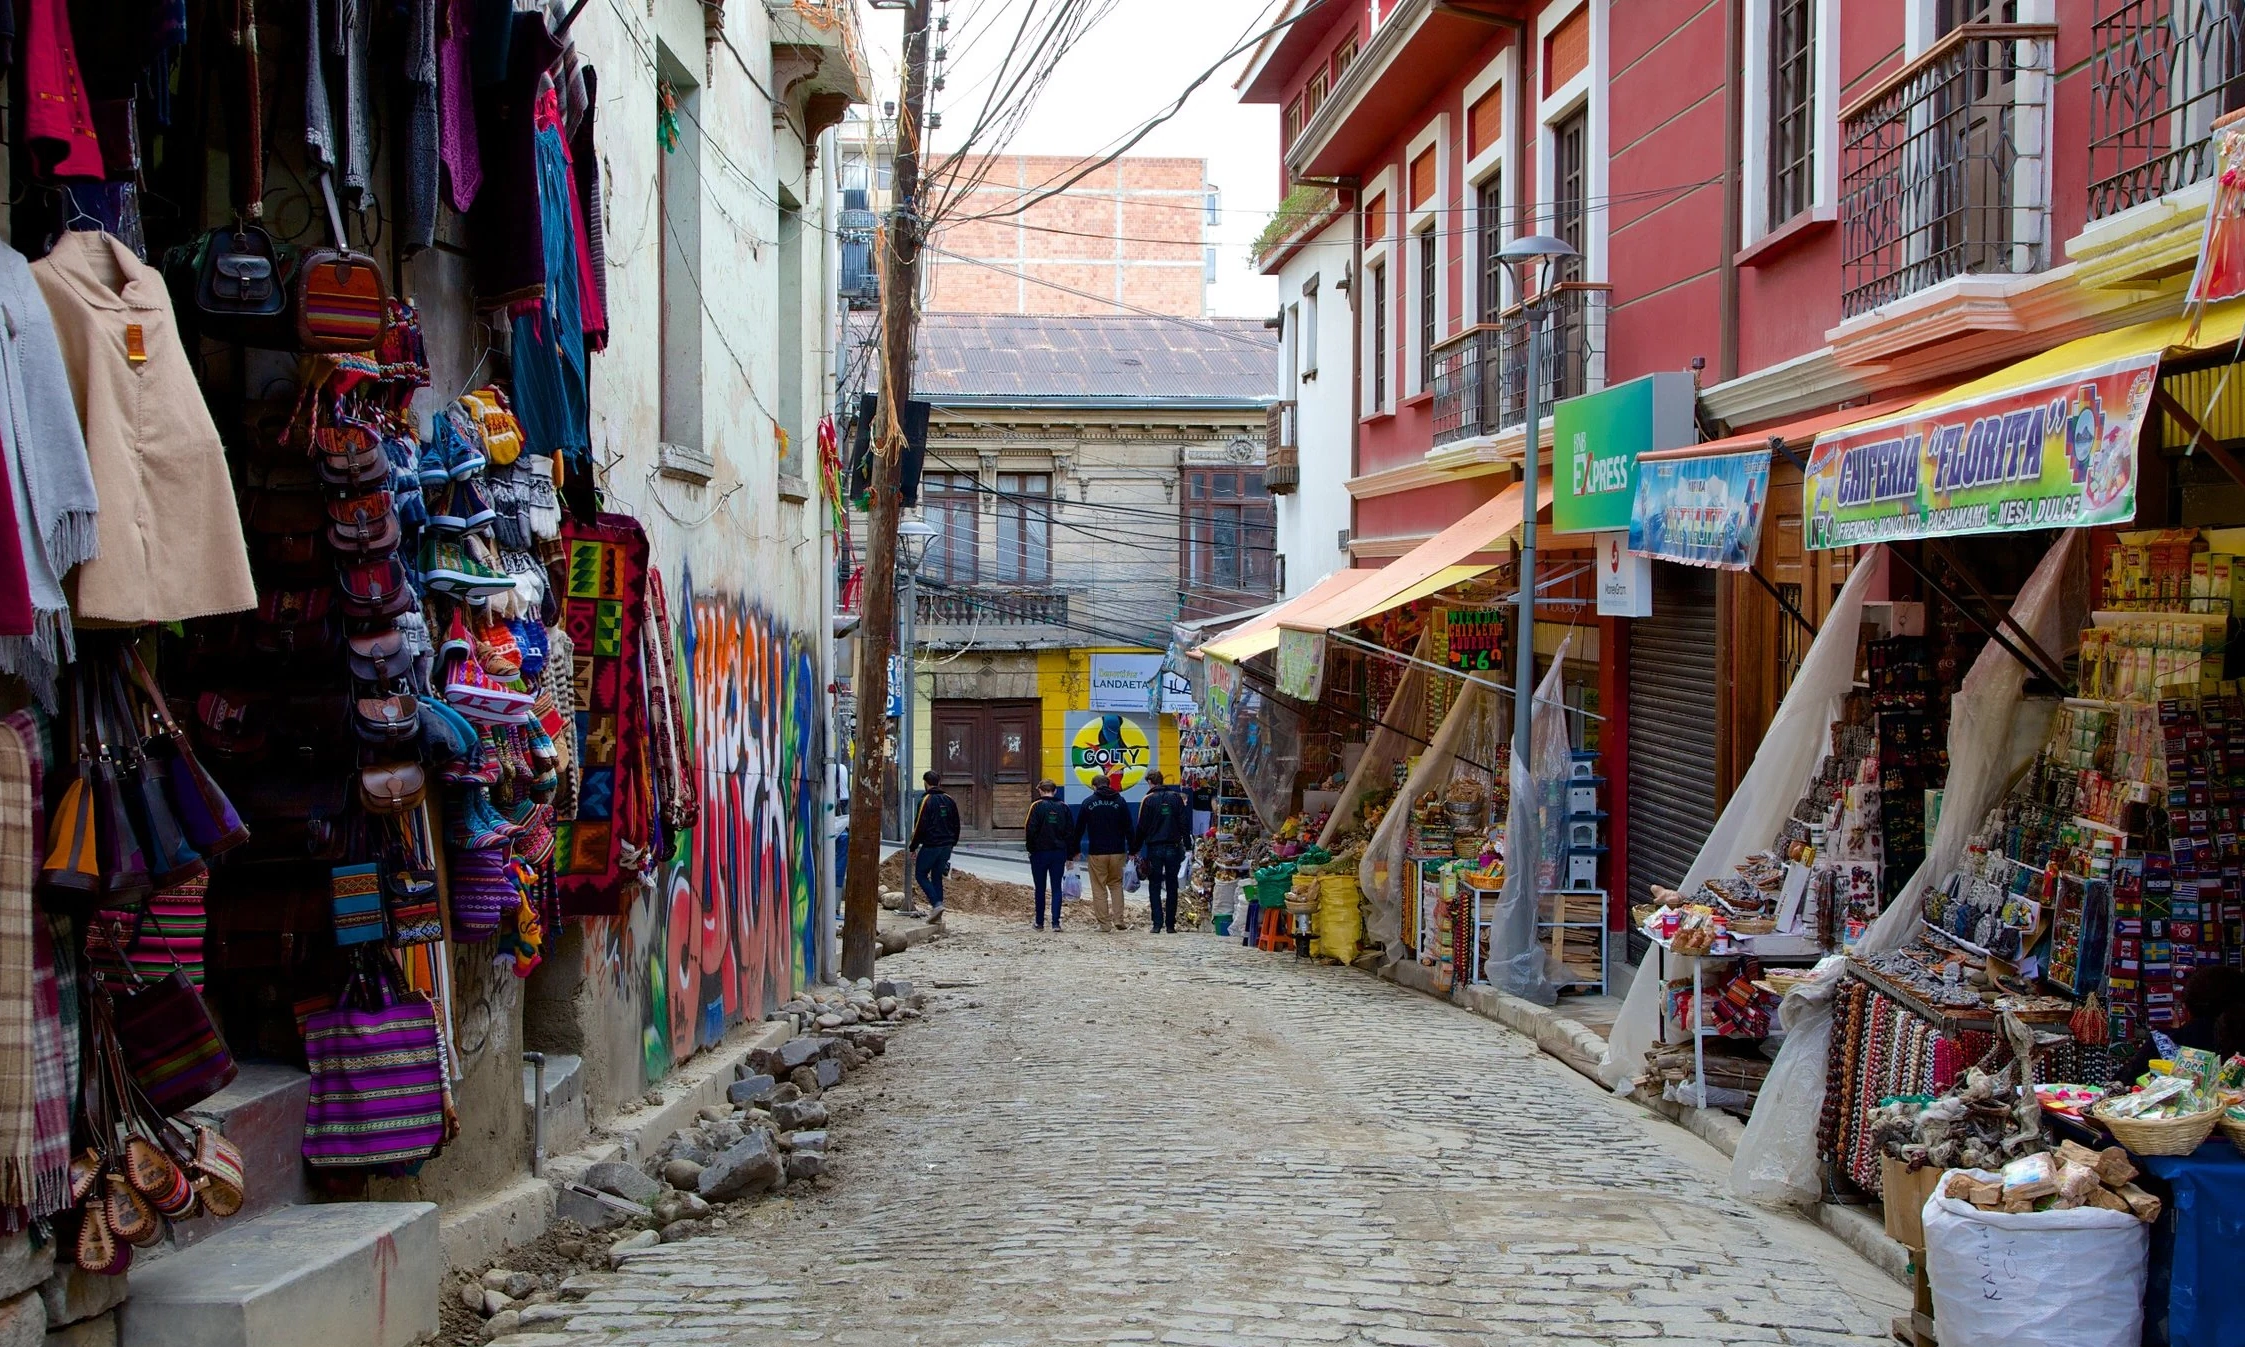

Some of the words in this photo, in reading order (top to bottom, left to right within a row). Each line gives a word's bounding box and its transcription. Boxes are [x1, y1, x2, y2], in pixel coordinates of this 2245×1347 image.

[1574, 431, 1586, 454] BNB
[1574, 452, 1627, 496] EXPRESS
[1837, 434, 1922, 507] CHIFERIA
[1877, 512, 1921, 536] MONOLITO
[1927, 504, 1989, 532] PACHAMAMA
[1997, 495, 2032, 526] MESA
[2033, 493, 2081, 523] DULCE
[1825, 515, 1835, 547] 9
[1449, 611, 1499, 624] TIENDA
[1450, 636, 1499, 650] LOURDES
[1093, 679, 1149, 689] LANDAETA
[1084, 748, 1140, 764] GOLTY
[2179, 1059, 2204, 1072] COCA
